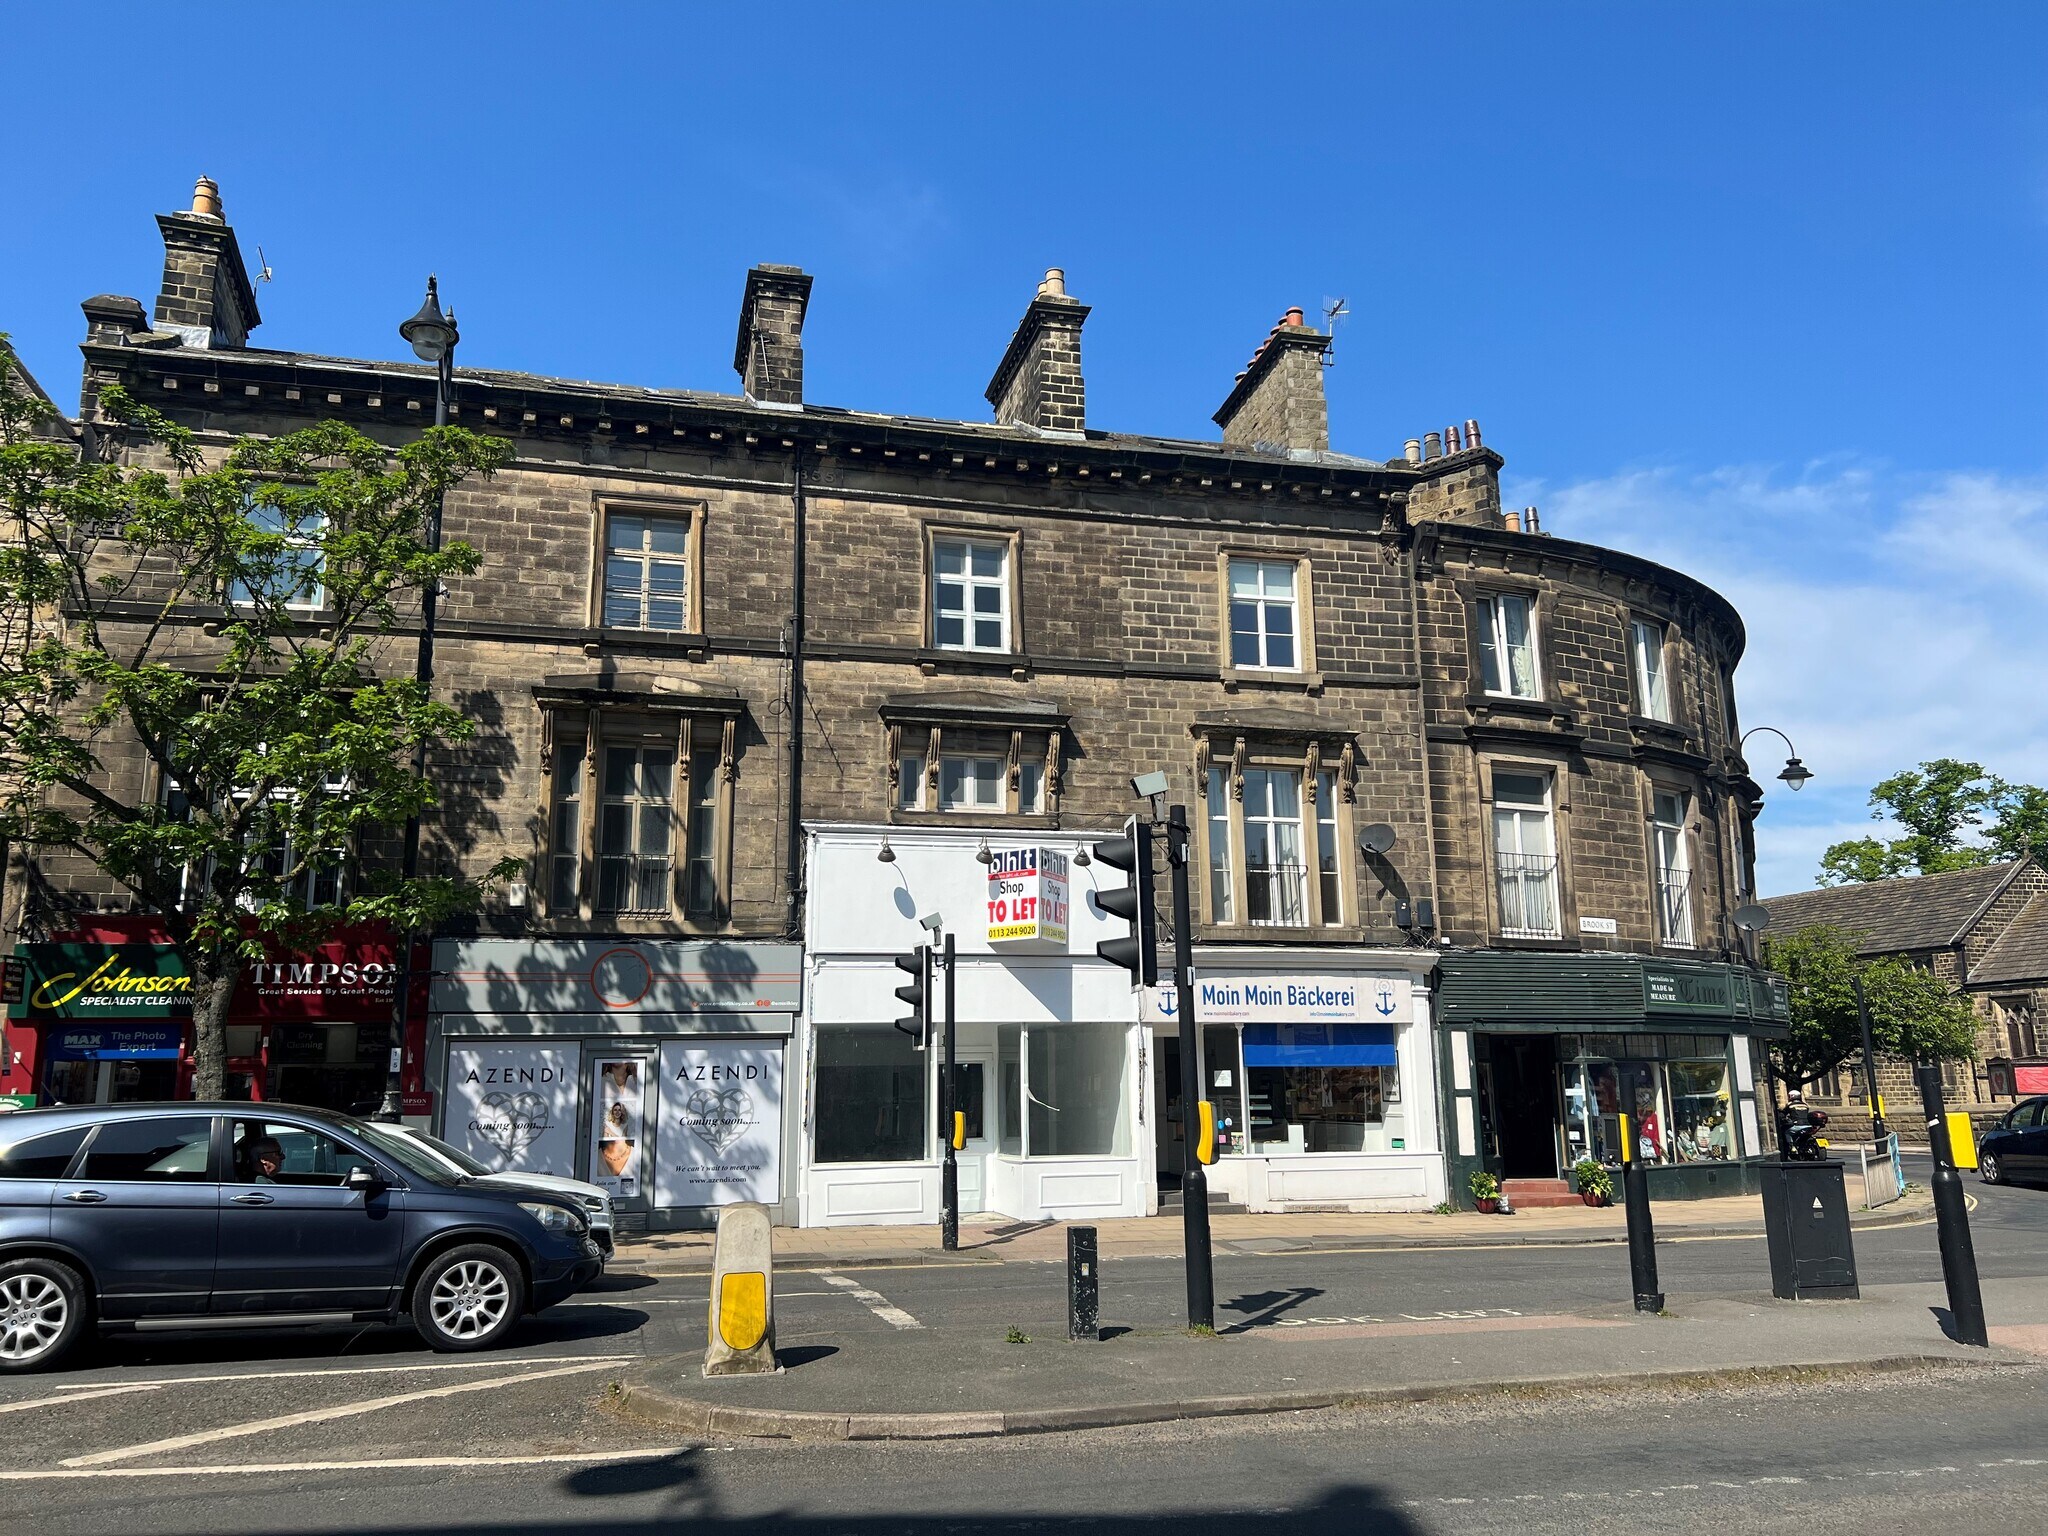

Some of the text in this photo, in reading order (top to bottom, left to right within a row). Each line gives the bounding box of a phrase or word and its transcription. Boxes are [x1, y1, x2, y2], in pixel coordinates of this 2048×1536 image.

[989, 849, 1035, 874] bht
[1042, 850, 1066, 876] bht
[1000, 881, 1024, 896] Shop
[1047, 880, 1061, 900] Shop
[988, 897, 1037, 923] TO LET
[1041, 898, 1067, 925] TO LET
[1582, 920, 1605, 929] BROOK
[988, 926, 1036, 938] 0113 244 9020
[287, 987, 322, 995] Service
[325, 988, 336, 996] By
[1202, 984, 1355, 1006] Moin Moin Bäckerei
[1650, 992, 1676, 1001] MEASURE
[80, 996, 194, 1006] SPECIALIST CLEANIN
[63, 1035, 101, 1045] MAX
[111, 1032, 166, 1041] The Photo
[298, 1031, 314, 1040] Dry
[119, 1042, 156, 1053] Expert
[286, 1041, 323, 1050] Cleaning
[466, 1067, 564, 1084] AZENDI
[675, 1065, 768, 1081] AZENDI
[468, 1120, 509, 1131] Coming
[679, 1116, 718, 1127] Coming
[746, 1164, 761, 1172] you.
[1274, 1308, 1522, 1326] OOK LEFT
